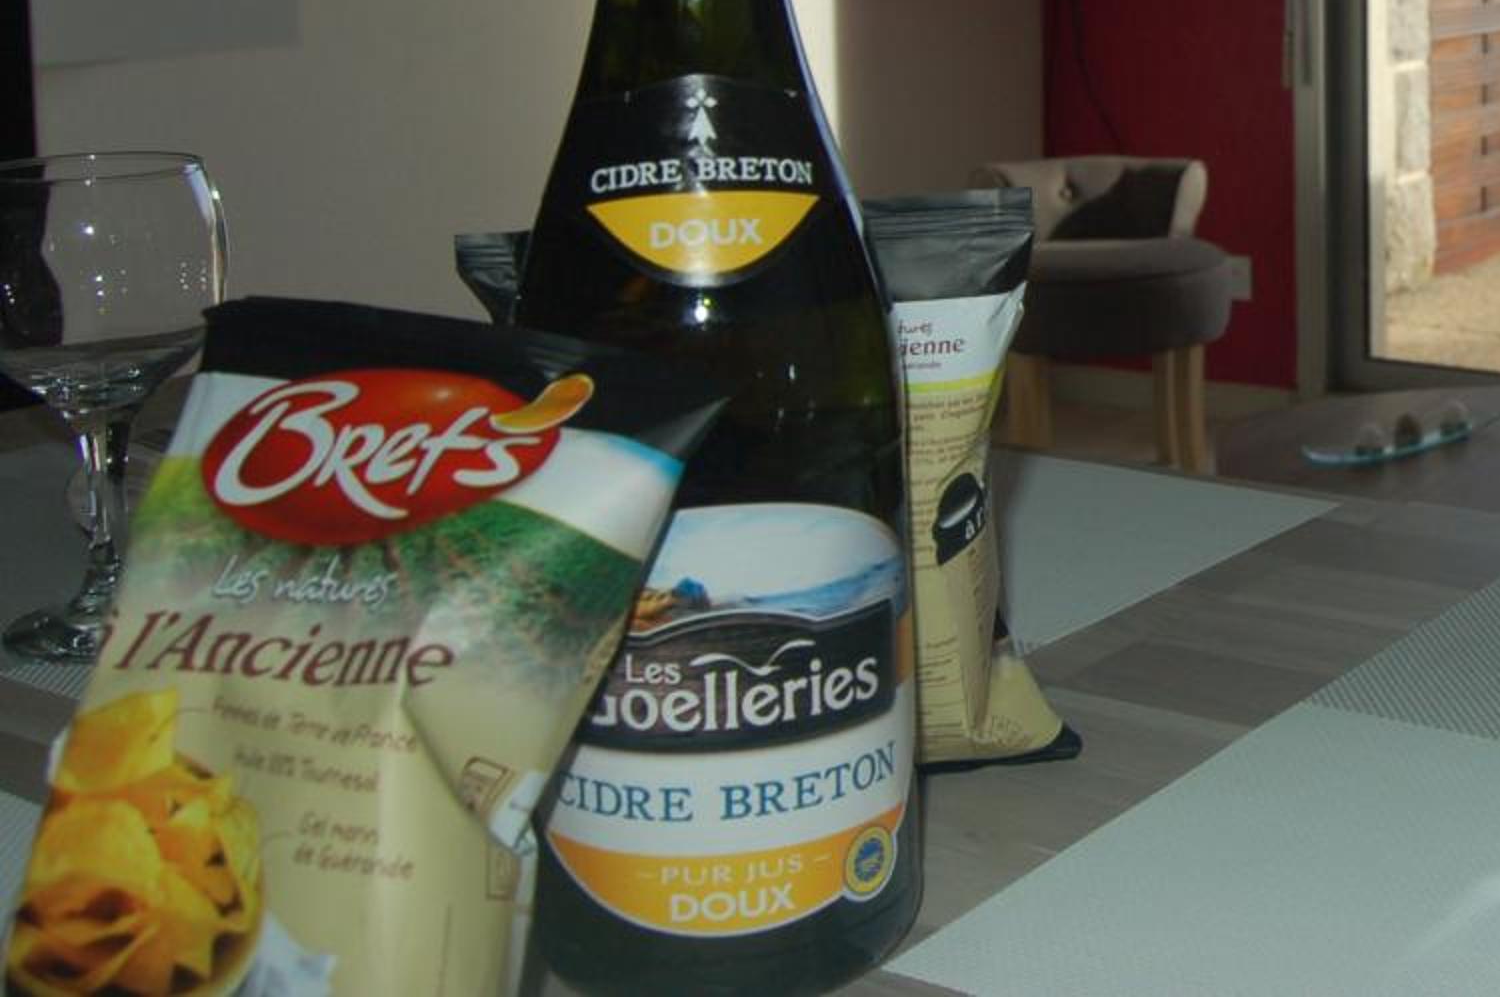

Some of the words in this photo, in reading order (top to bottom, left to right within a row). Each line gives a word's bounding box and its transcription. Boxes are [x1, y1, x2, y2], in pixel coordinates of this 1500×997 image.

[591, 158, 682, 193] CIDRE
[694, 156, 813, 185] BRETON
[650, 218, 762, 249] DOUX
[212, 555, 270, 601] Les
[273, 556, 397, 606] natures
[625, 654, 681, 685] Les
[720, 741, 896, 821] BRETON
[661, 865, 733, 886] PUR
[746, 854, 804, 884] JUS
[670, 882, 796, 922] DOUX
